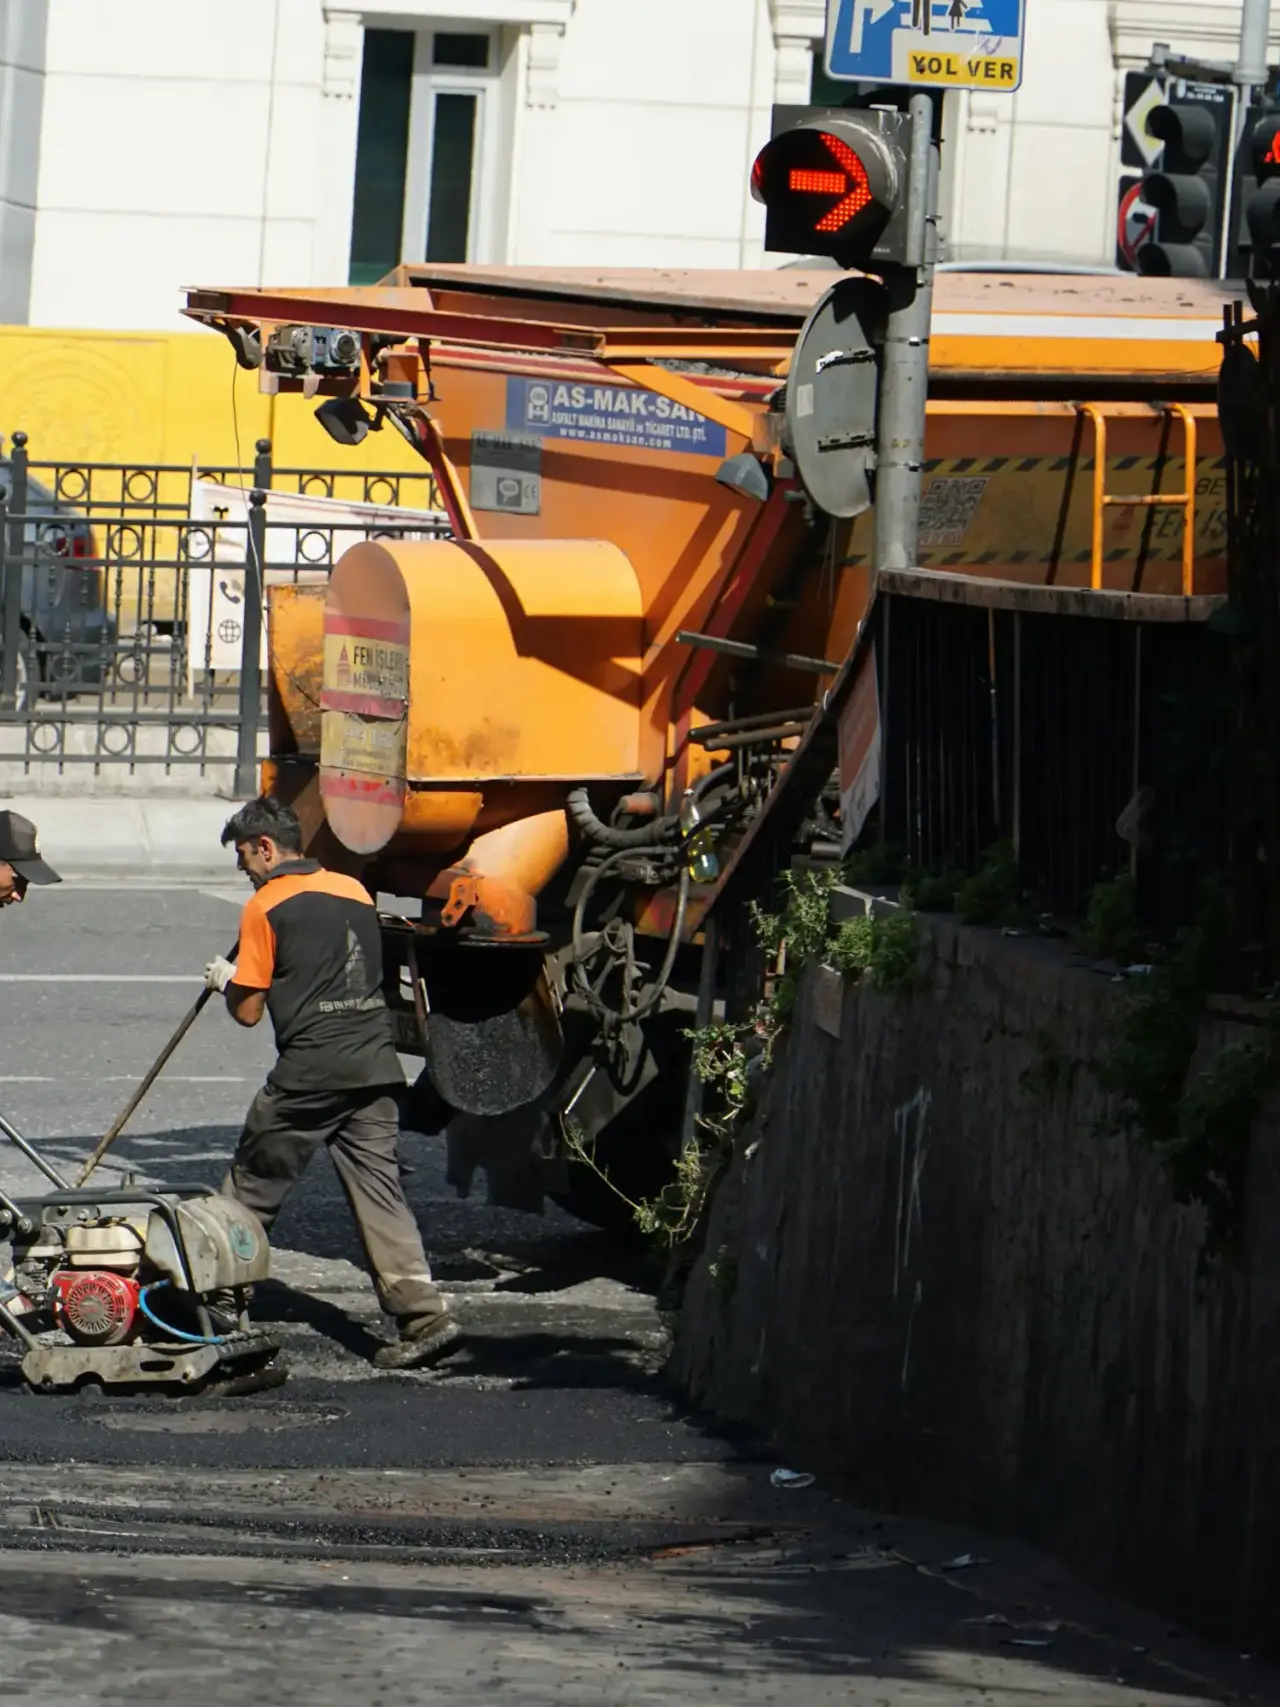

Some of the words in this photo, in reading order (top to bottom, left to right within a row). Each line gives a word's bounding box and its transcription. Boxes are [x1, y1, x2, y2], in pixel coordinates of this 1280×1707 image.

[912, 55, 957, 75] YOL
[967, 59, 1013, 80] VER
[552, 410, 577, 425] ASFALT
[1195, 476, 1227, 496] BE
